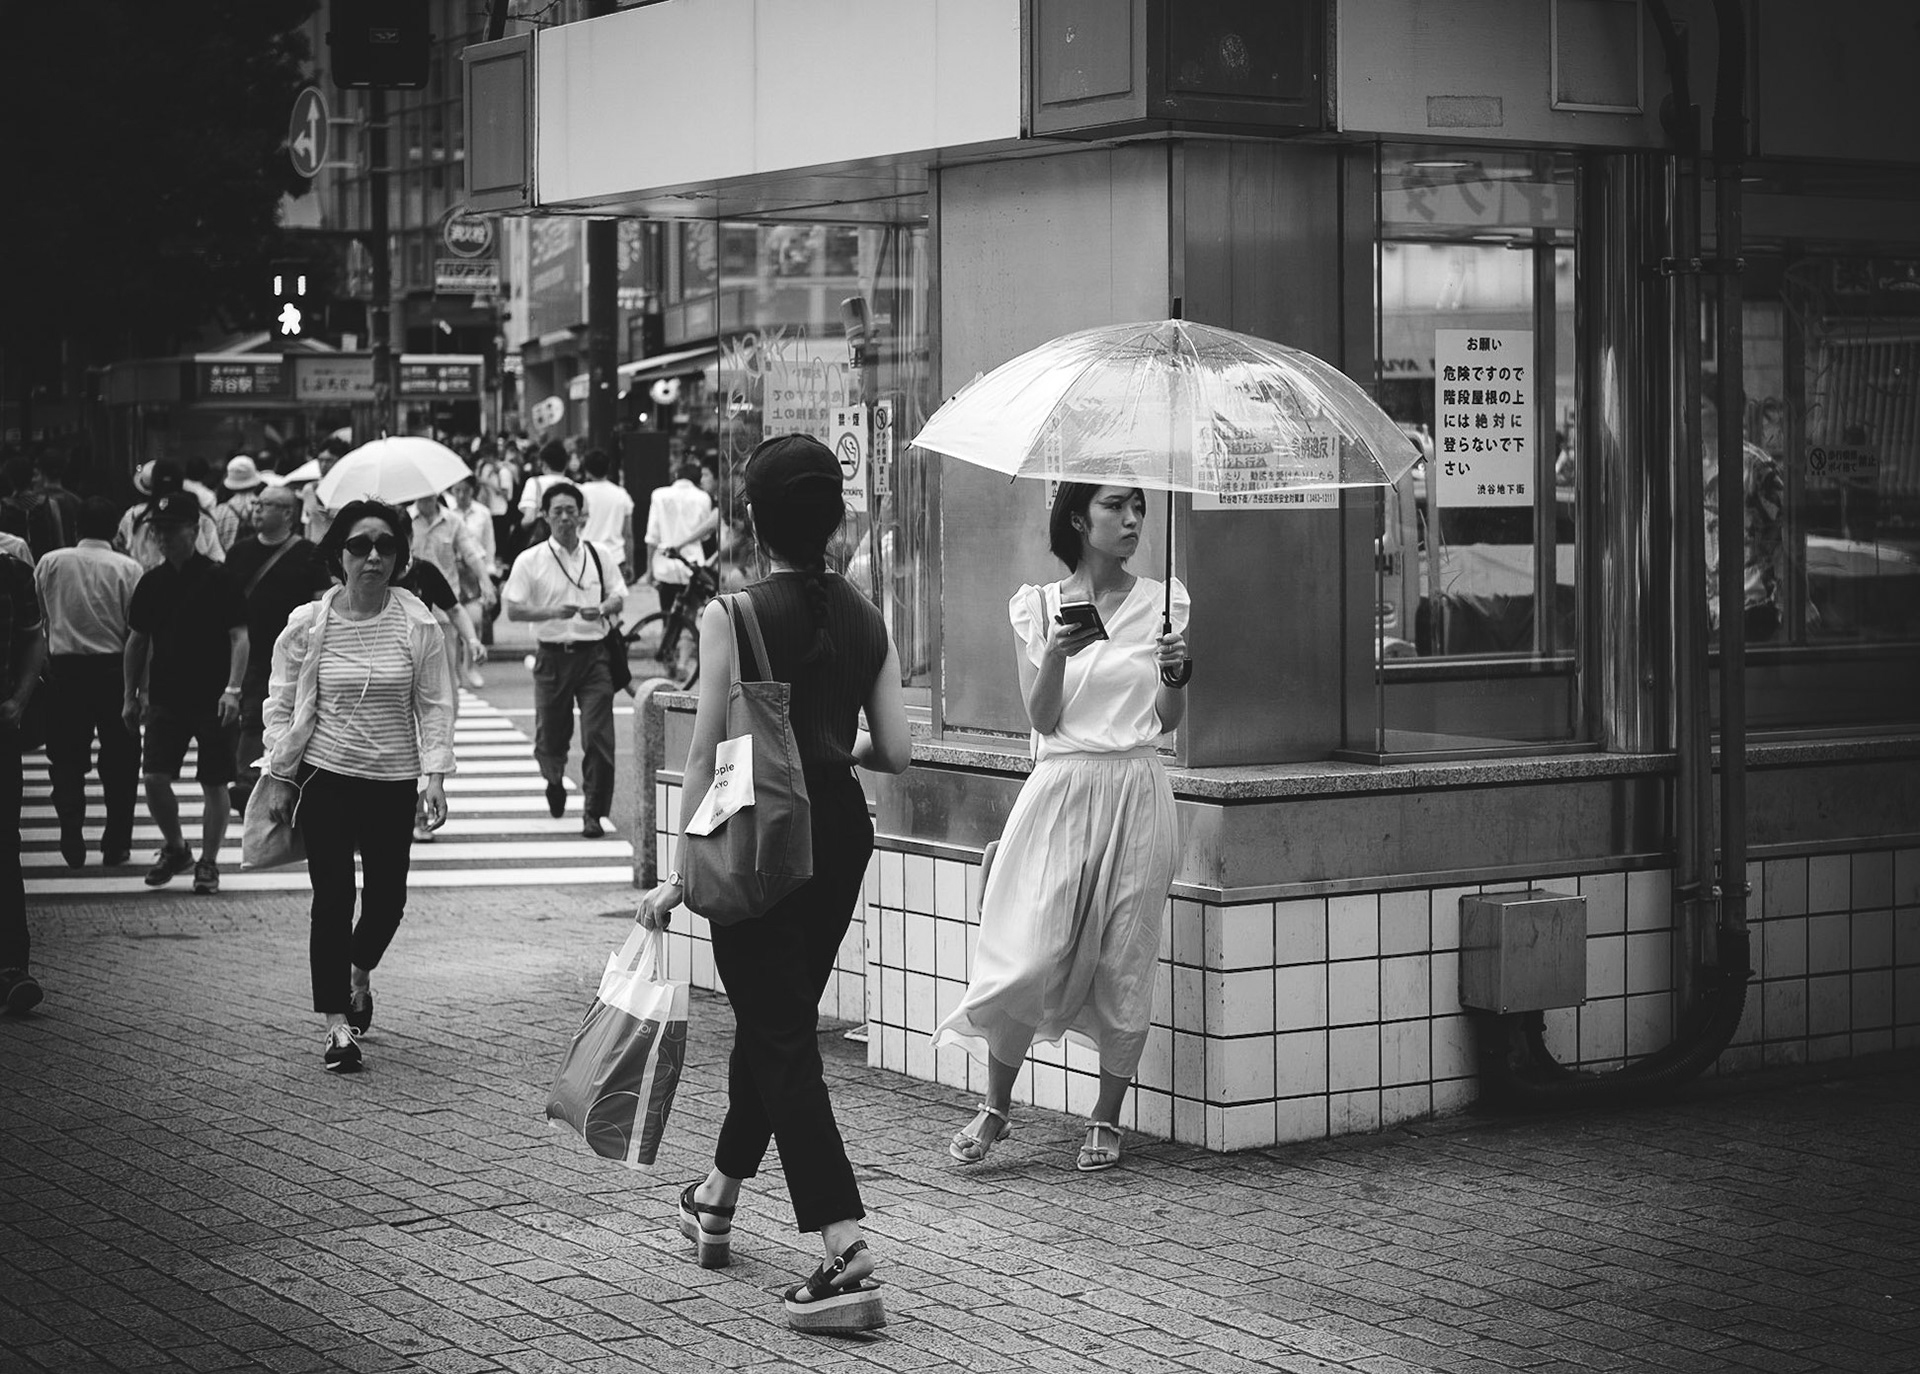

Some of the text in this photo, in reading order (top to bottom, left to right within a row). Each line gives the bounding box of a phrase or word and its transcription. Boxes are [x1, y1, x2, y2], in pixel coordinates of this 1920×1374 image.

[1466, 337, 1502, 351] お願い
[1443, 365, 1525, 381] 危険ですので
[1443, 389, 1525, 405] 階段屋根の上
[1444, 413, 1522, 429] には絶対に
[1443, 437, 1525, 452] 登らないで下
[1444, 461, 1470, 476] さい
[1477, 484, 1525, 495] 渋谷地下街
